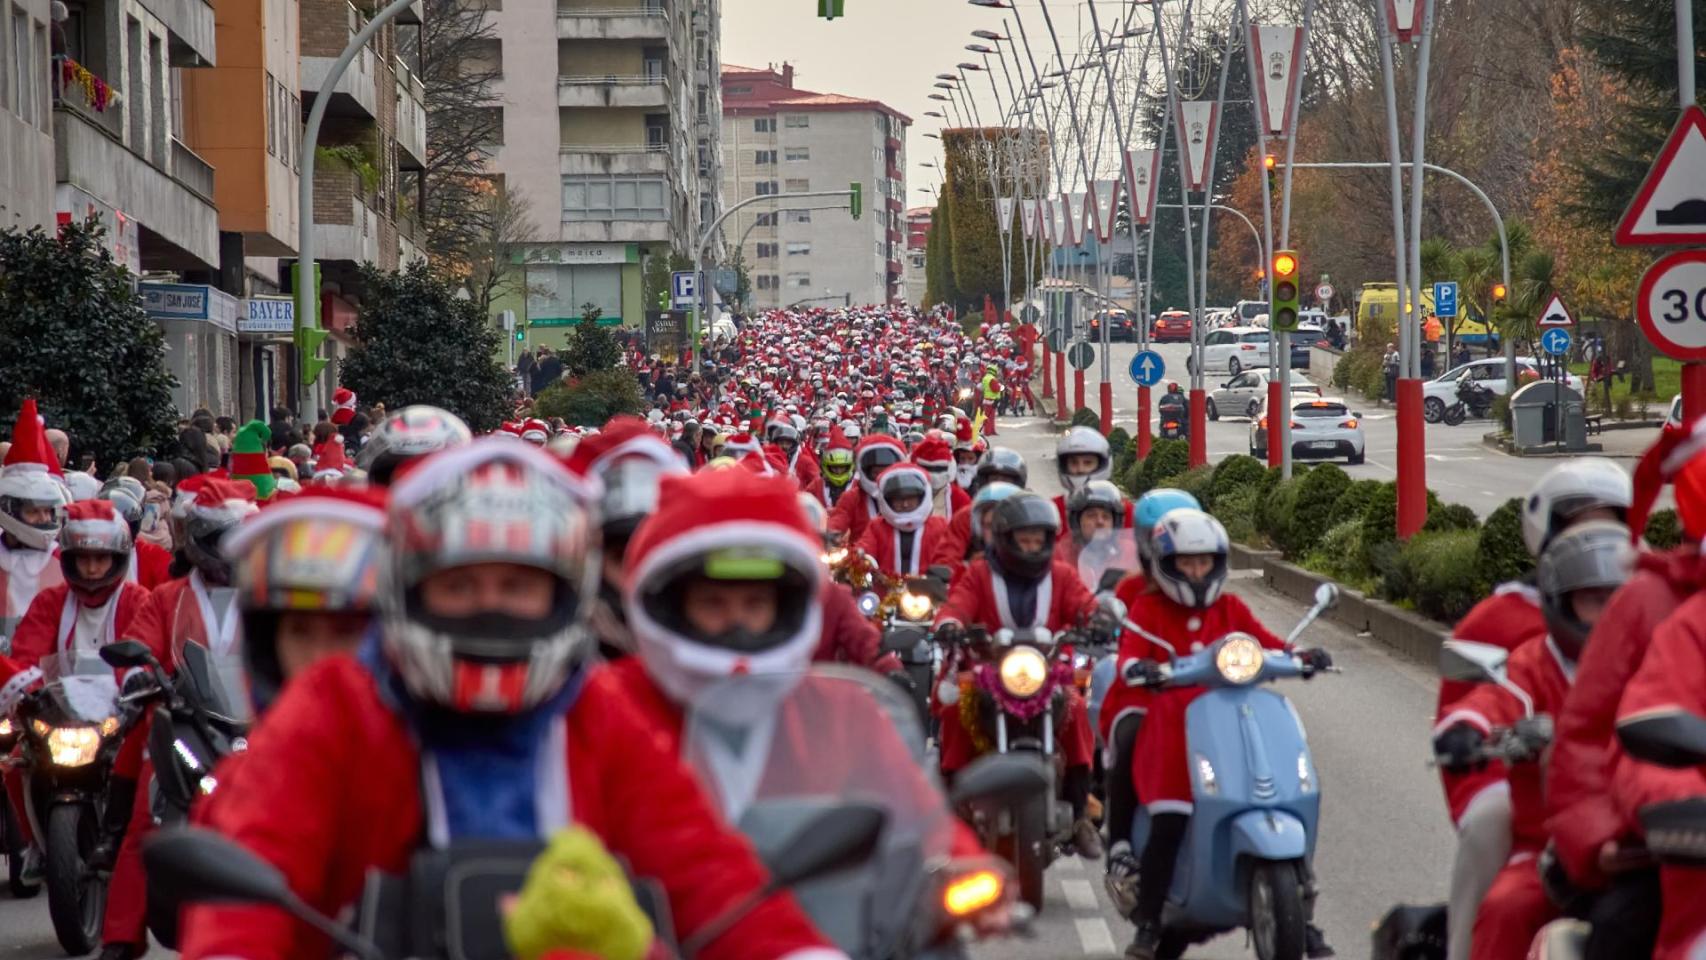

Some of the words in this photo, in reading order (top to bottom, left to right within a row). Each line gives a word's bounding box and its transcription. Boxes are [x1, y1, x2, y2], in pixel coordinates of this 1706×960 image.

[680, 275, 696, 296] P
[1441, 286, 1452, 300] P
[166, 293, 182, 307] SAN
[250, 301, 292, 320] BAYER
